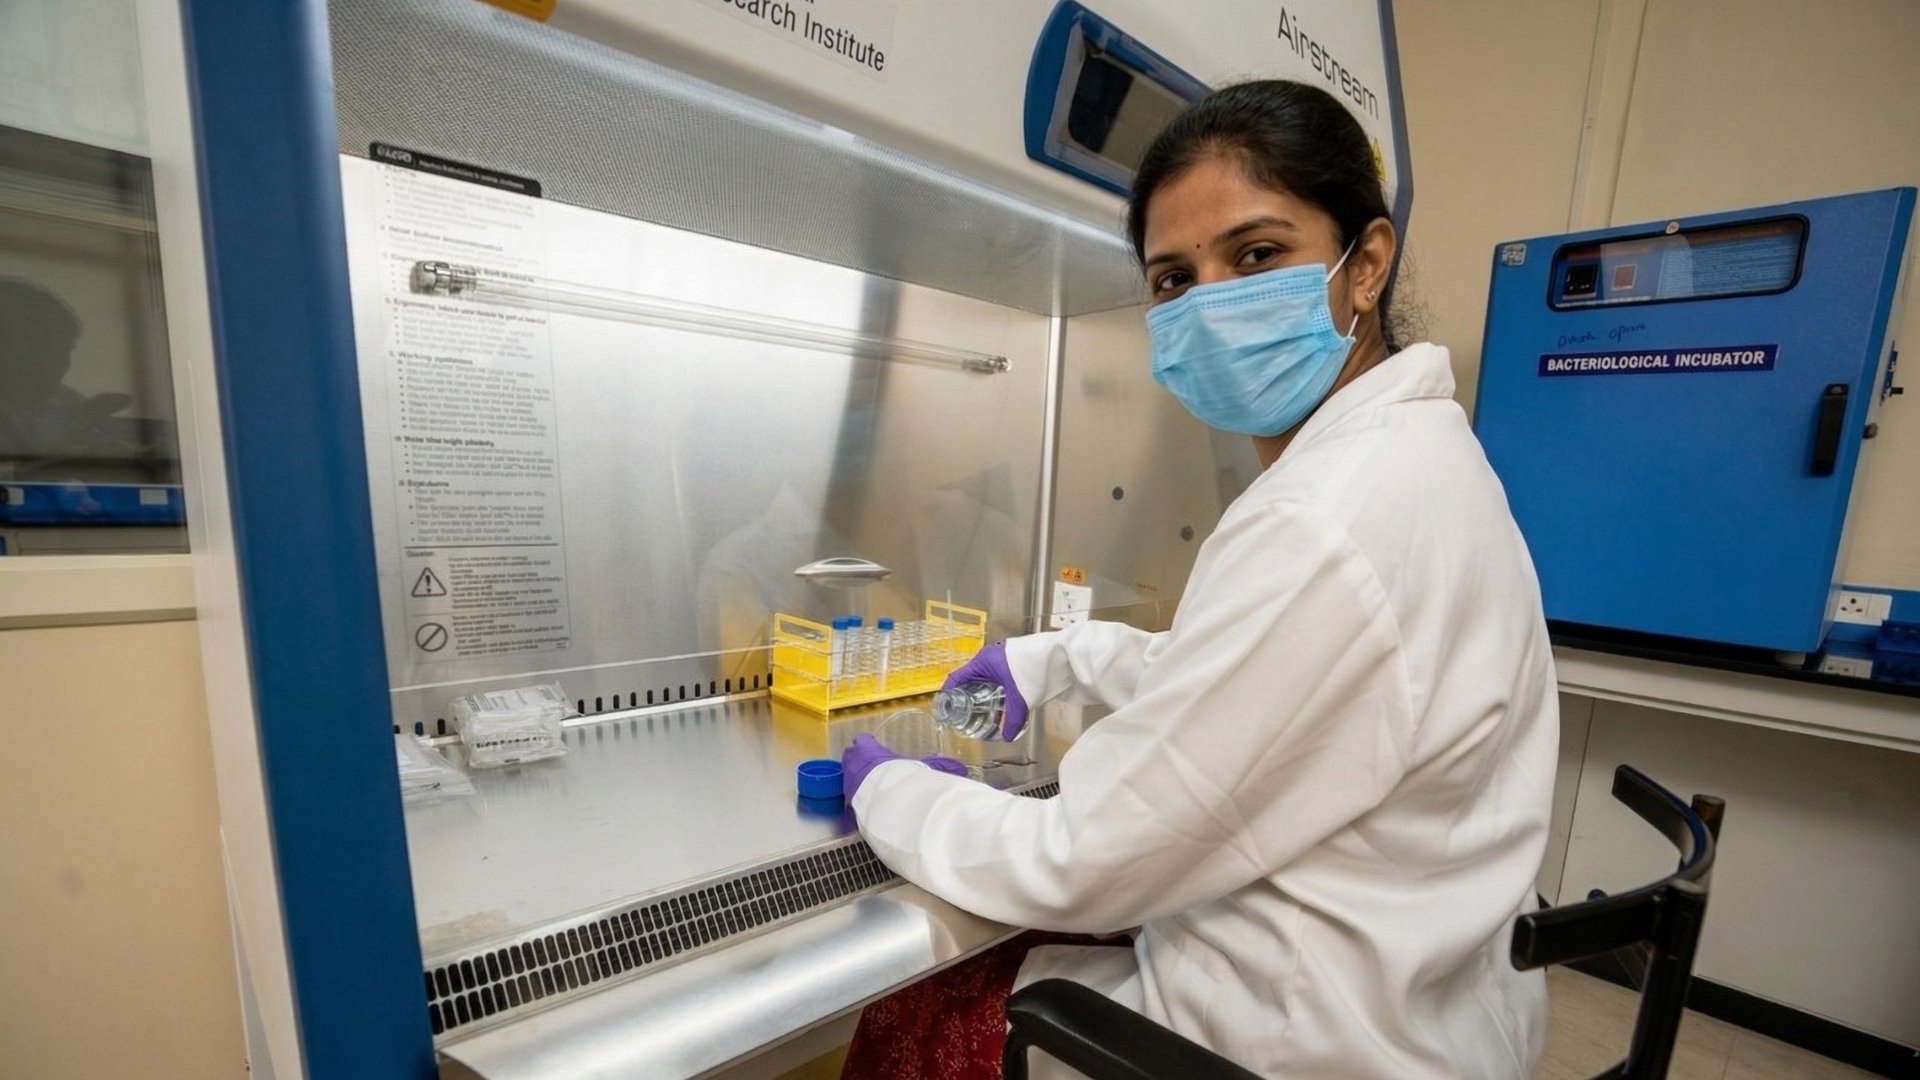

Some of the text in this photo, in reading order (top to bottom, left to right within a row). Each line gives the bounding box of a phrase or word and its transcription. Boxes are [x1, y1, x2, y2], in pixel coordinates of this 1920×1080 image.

[804, 12, 885, 71] Institute
[1278, 7, 1379, 120] Airstream
[1547, 351, 1765, 371] BACTERIOLOGICAL INCUBATOR
